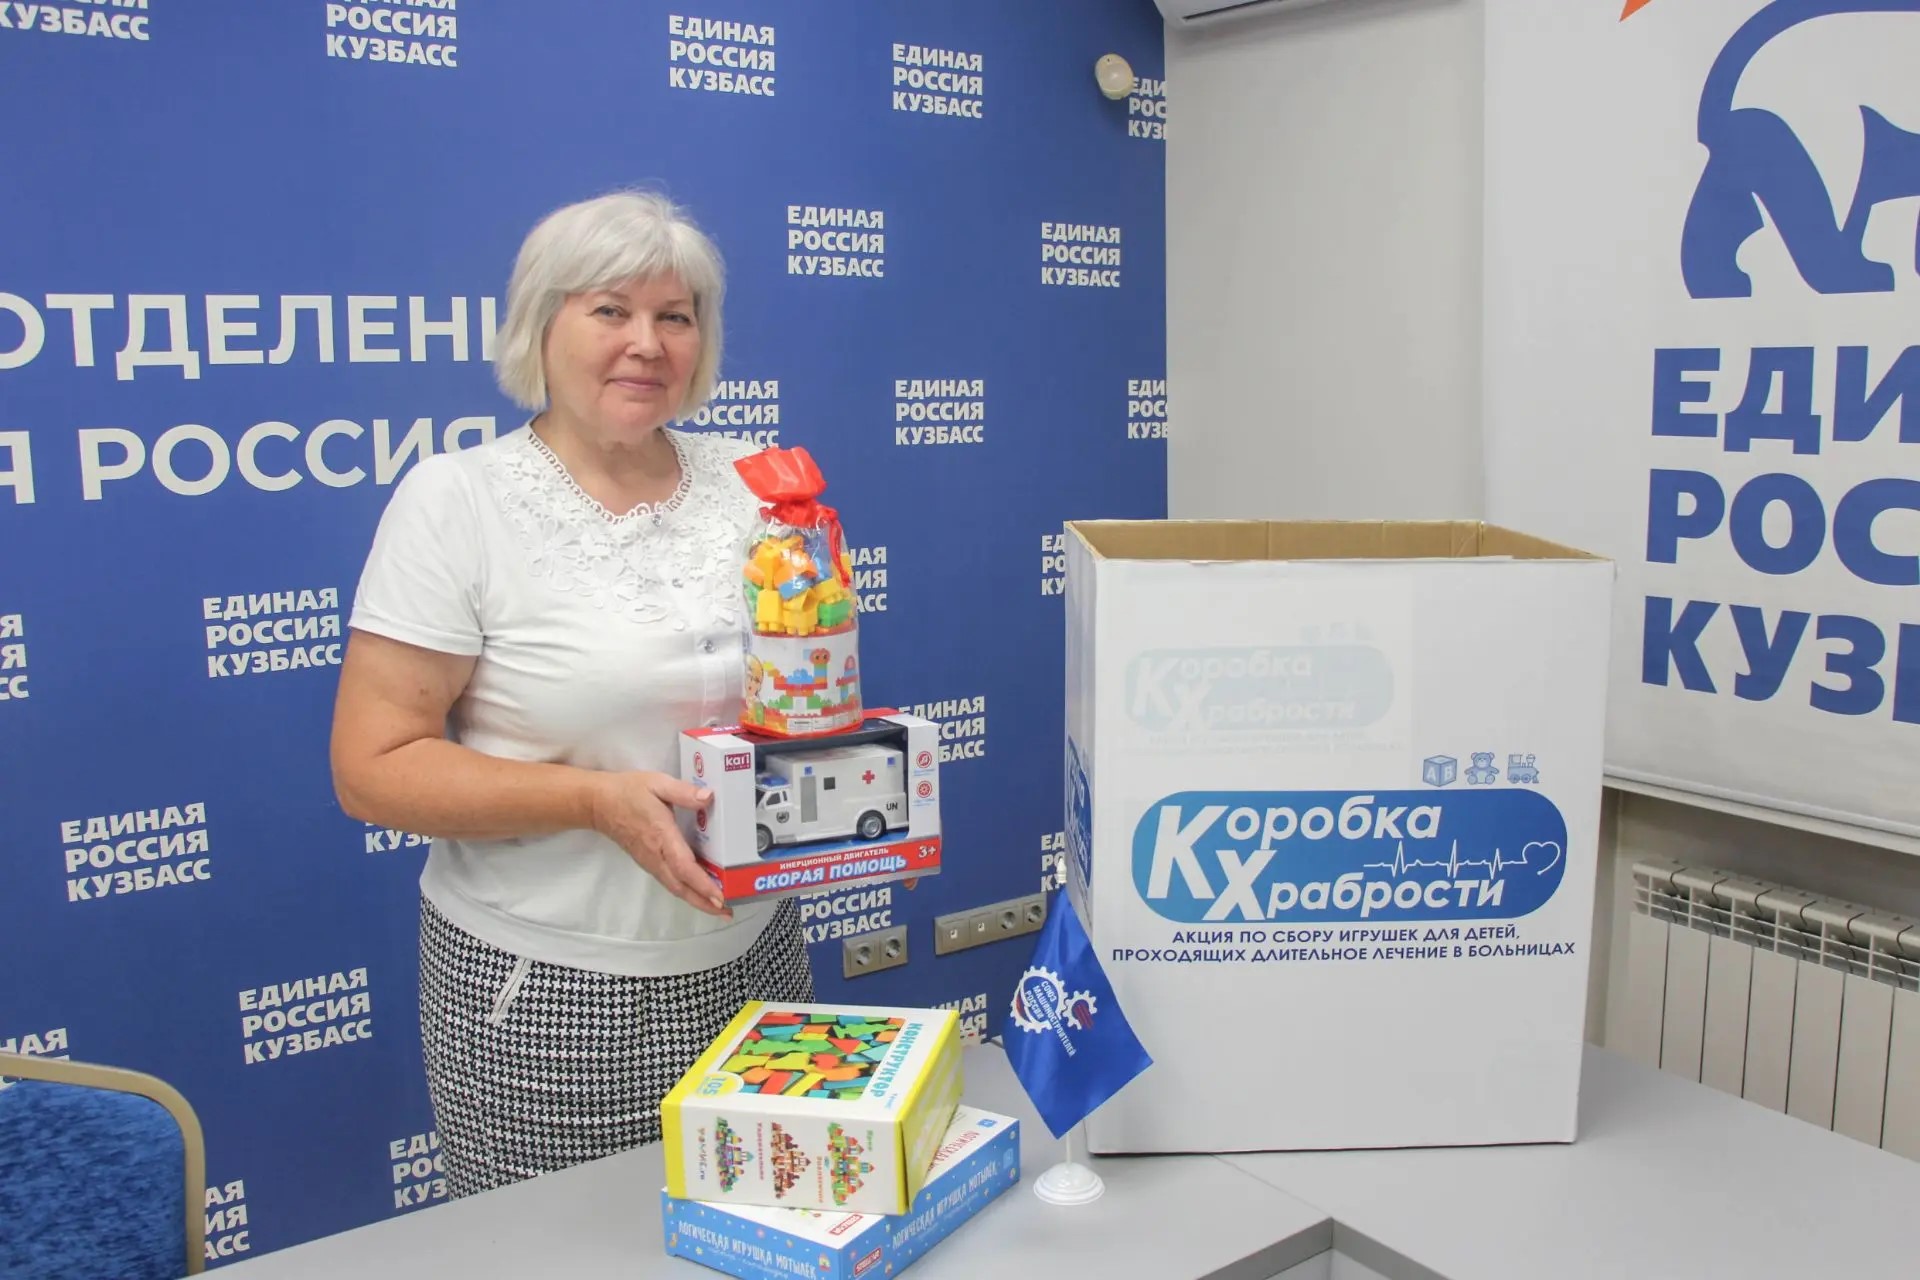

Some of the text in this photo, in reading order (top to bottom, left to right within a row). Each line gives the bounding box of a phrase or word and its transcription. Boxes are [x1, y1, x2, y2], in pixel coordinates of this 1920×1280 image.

[326, 3, 457, 39] РОССИЯ
[669, 15, 775, 46] ЕДИНАЯ
[326, 34, 457, 67] КУЗБАСС
[669, 40, 775, 72] РОССИЯ
[892, 43, 983, 72] ЕДИНАЯ
[669, 67, 775, 97] КУЗБАСС
[893, 67, 983, 96] РОССИЯ
[892, 91, 983, 119] КУЗБАСС
[787, 205, 884, 230] ЕДИНАЯ
[788, 229, 884, 254] РОССИЯ
[1041, 222, 1121, 244] ЕДИНАЯ
[788, 255, 884, 278] КУЗБАСС
[1041, 244, 1121, 267] РОССИЯ
[1041, 266, 1121, 288] КУЗБАСС
[895, 380, 984, 400] ЕДИНАЯ
[677, 404, 779, 427] ОССИЯ
[895, 401, 984, 422] РОССИЯ
[1128, 400, 1168, 418] РОС
[895, 424, 984, 445] КУЗБАСС
[203, 587, 338, 620] ЕДИНАЯ
[205, 614, 341, 649] РОССИЯ
[207, 643, 342, 678] КУЗБАСС
[939, 717, 985, 740] СИЯ
[725, 754, 750, 767] kari
[886, 802, 898, 811] UN
[61, 802, 206, 844] ЕДИНАЯ
[65, 830, 209, 873] РОССИЯ
[780, 847, 889, 871] ИНЕРЦИОННЫЙ ДВИГАТЕЛЬ
[918, 845, 937, 859] 3+
[1147, 795, 1443, 900] Коробка
[67, 858, 211, 902] КУЗБАСС
[754, 866, 825, 891] СКОРАЯ
[829, 855, 908, 881] ПОМОЩЬ
[1202, 848, 1505, 921] Храбрости
[801, 887, 892, 922] РОССИЯ
[803, 910, 892, 944] КУЗБАСС
[1172, 924, 1520, 944] АКЦИЯ ПО СБОРУ ИГРУШЕК ДЛЯ ДЕТЕЙ,
[1112, 942, 1576, 963] ПРОХОДЯЩИХ ДЛИТЕЛЬНОЕ ЛЕЧЕНИЕ В БОЛЬНИЦАХ
[239, 967, 369, 1012] ЕДИНАЯ
[1041, 980, 1057, 1003] СОЮЗ
[242, 992, 371, 1038] РОССИЯ
[1024, 990, 1044, 1019] РОССИИ
[244, 1018, 373, 1065] КУЗБАСС
[870, 1022, 924, 1097] КОНСТРУКТОР
[679, 1220, 729, 1251] ЛОГИЧЕСКАЯ
[732, 1239, 773, 1266] ИГРУШКА
